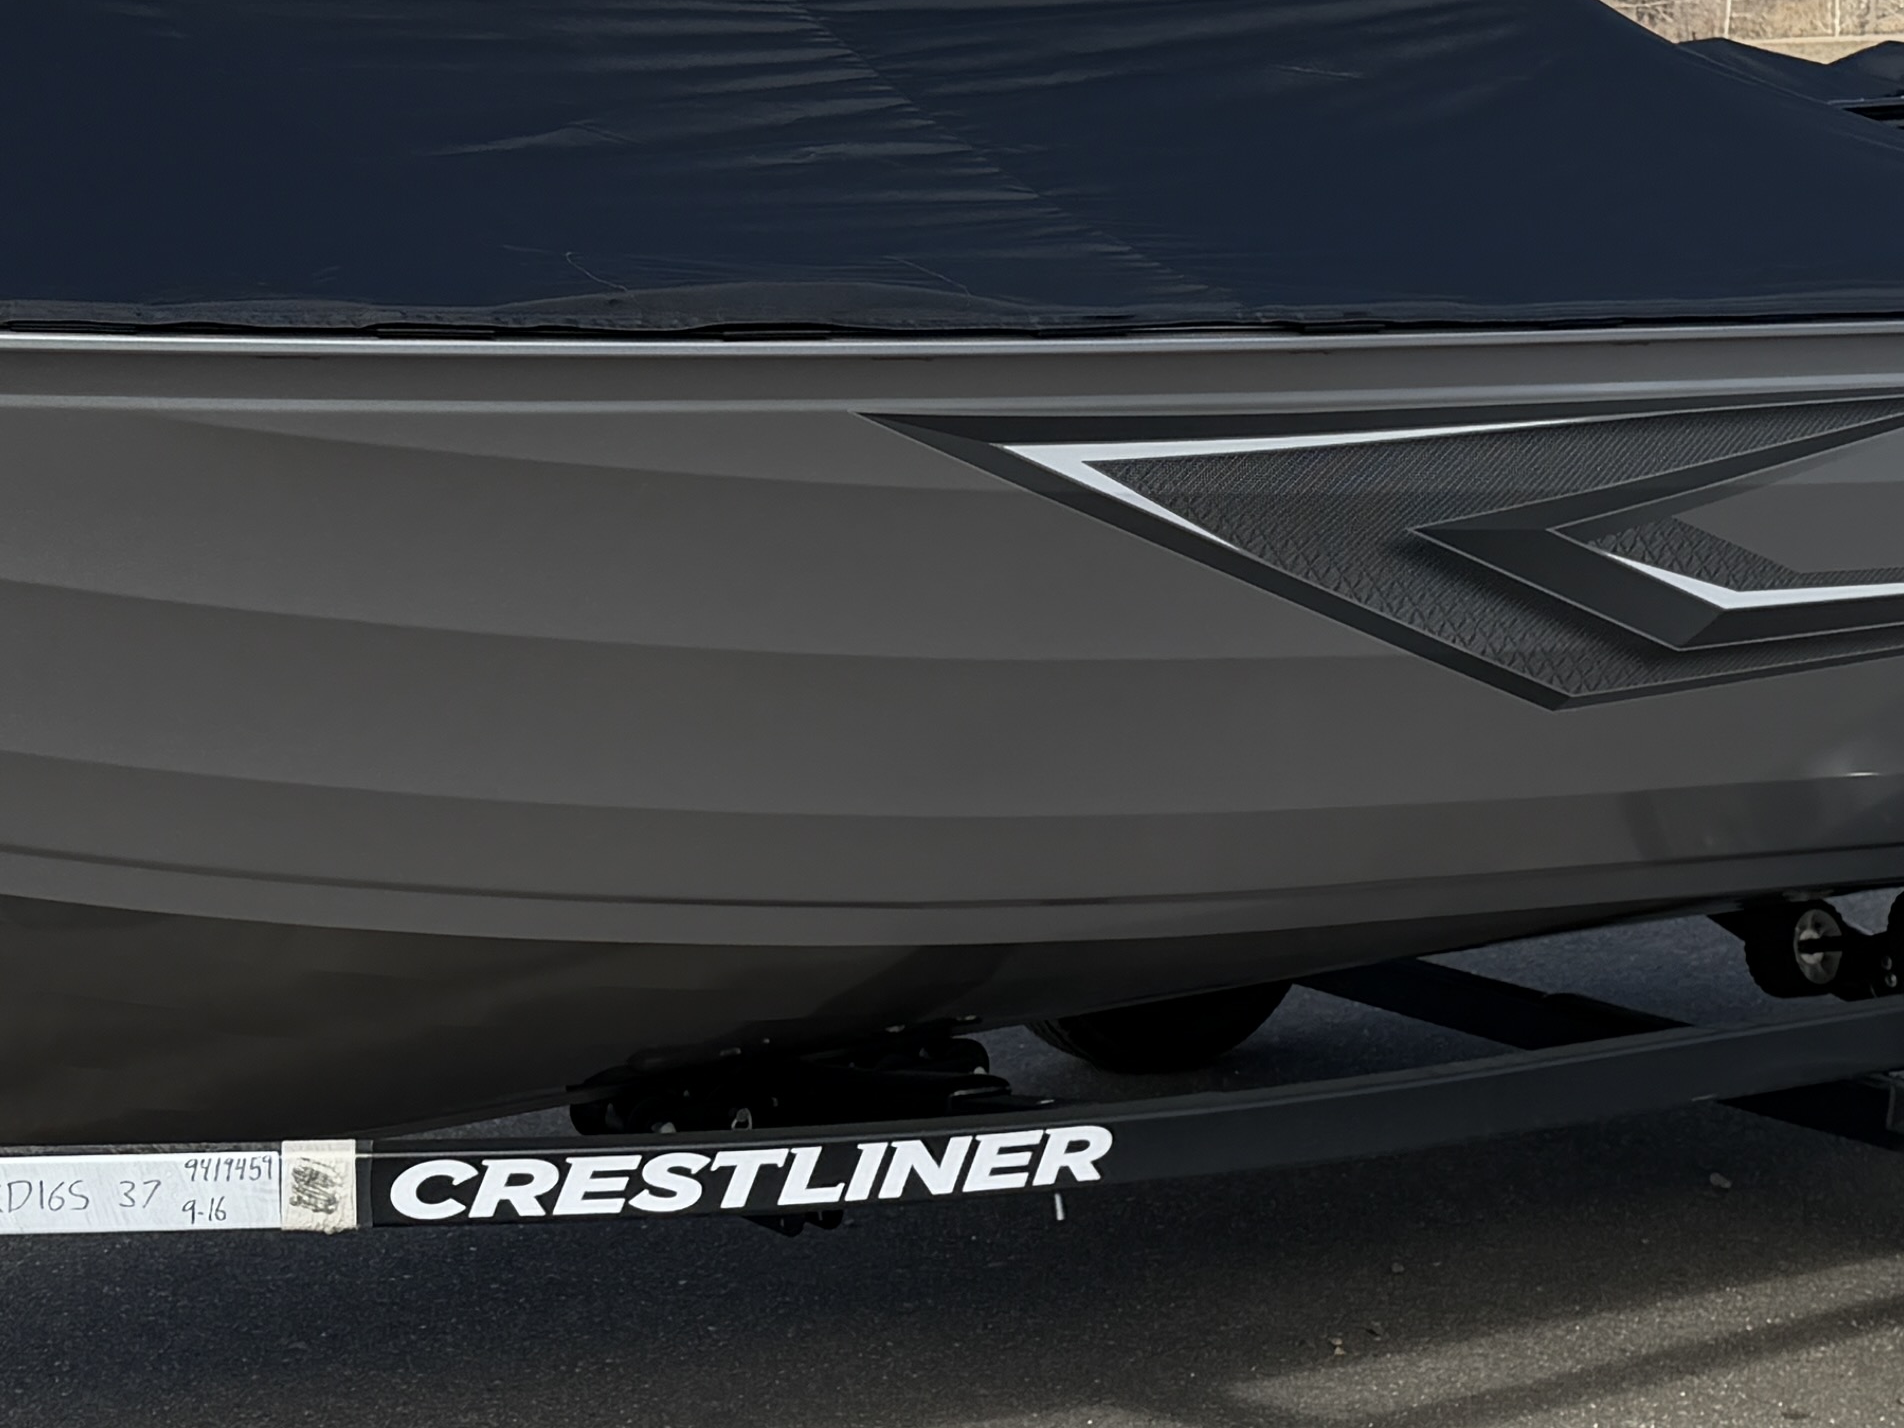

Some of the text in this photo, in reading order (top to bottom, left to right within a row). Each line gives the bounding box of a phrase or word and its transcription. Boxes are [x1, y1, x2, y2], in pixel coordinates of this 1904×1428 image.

[390, 1125, 1114, 1220] CRESTLINER
[118, 1179, 162, 1209] 37
[181, 1196, 228, 1224] 9-16
